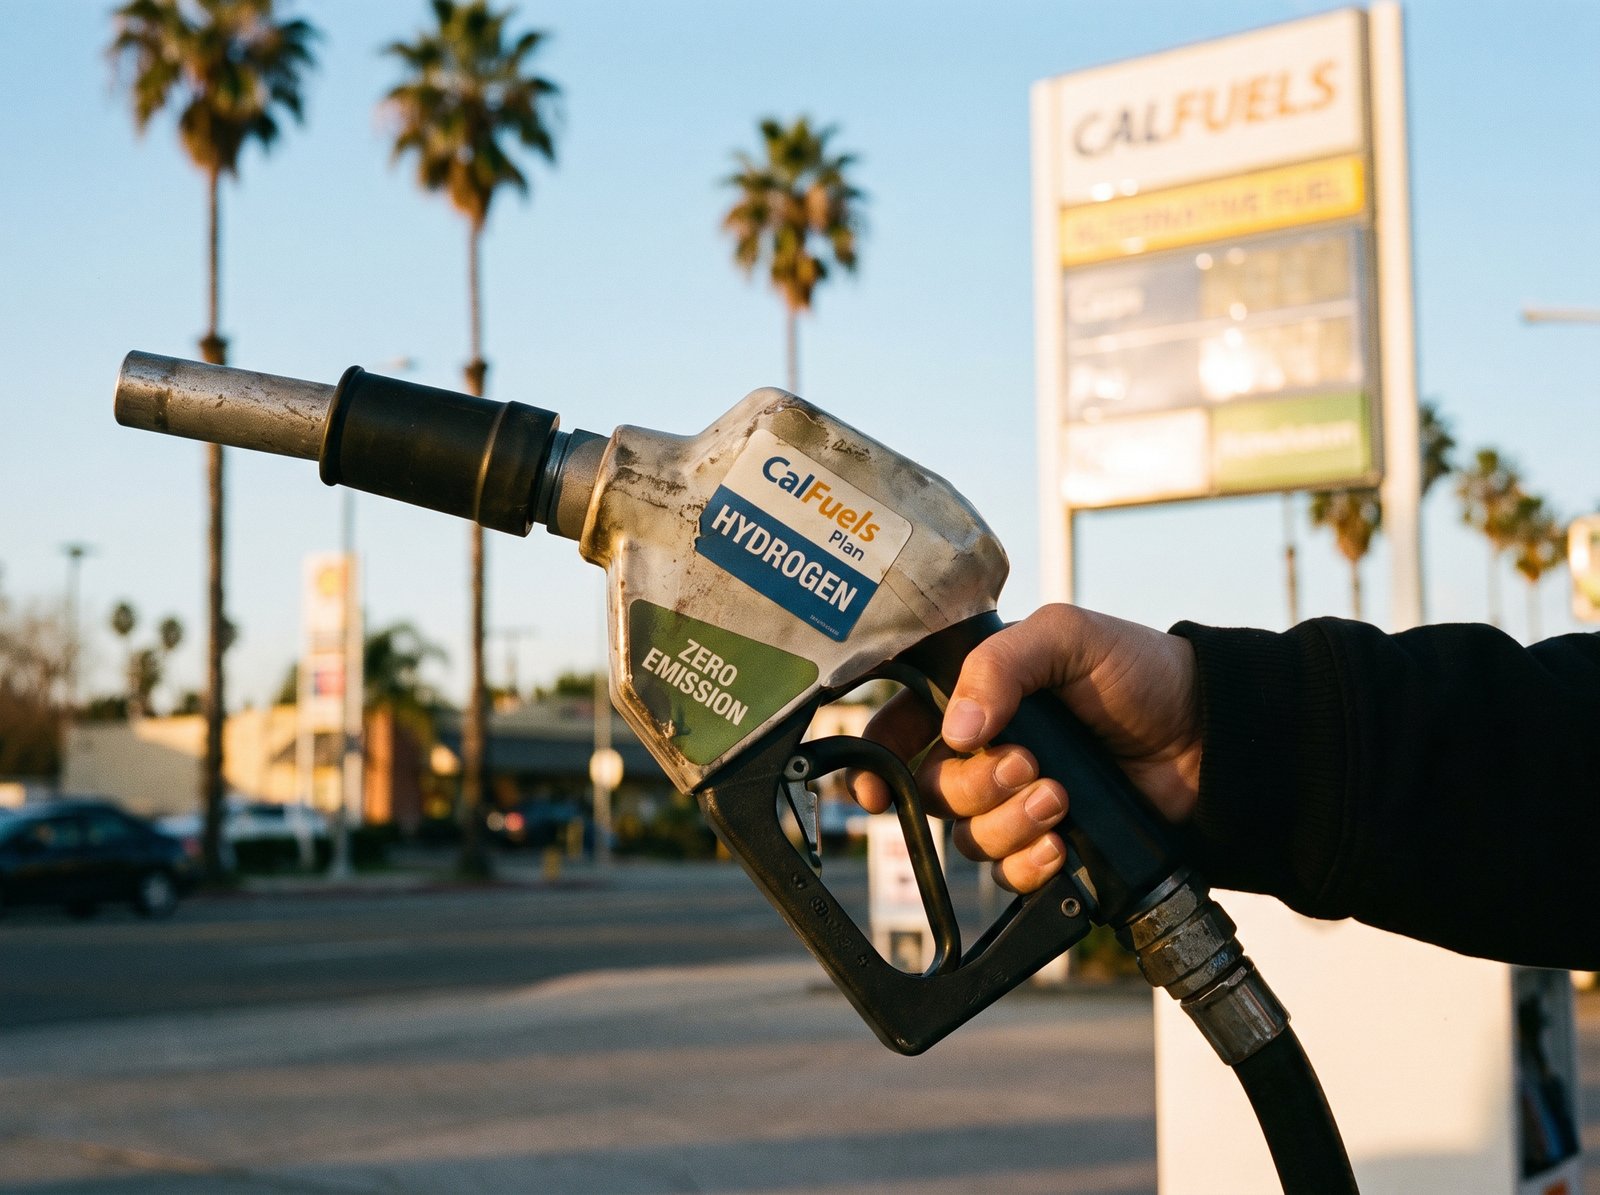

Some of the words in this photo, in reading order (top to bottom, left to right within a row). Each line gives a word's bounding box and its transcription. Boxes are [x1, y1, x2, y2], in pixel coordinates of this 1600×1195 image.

[1073, 57, 1338, 157] CALFUELS
[762, 456, 881, 542] CalFuels
[711, 504, 858, 613] HYDROGEN
[829, 530, 865, 562] Plan
[641, 647, 749, 726] EMISSION
[677, 638, 738, 687] ZERO
